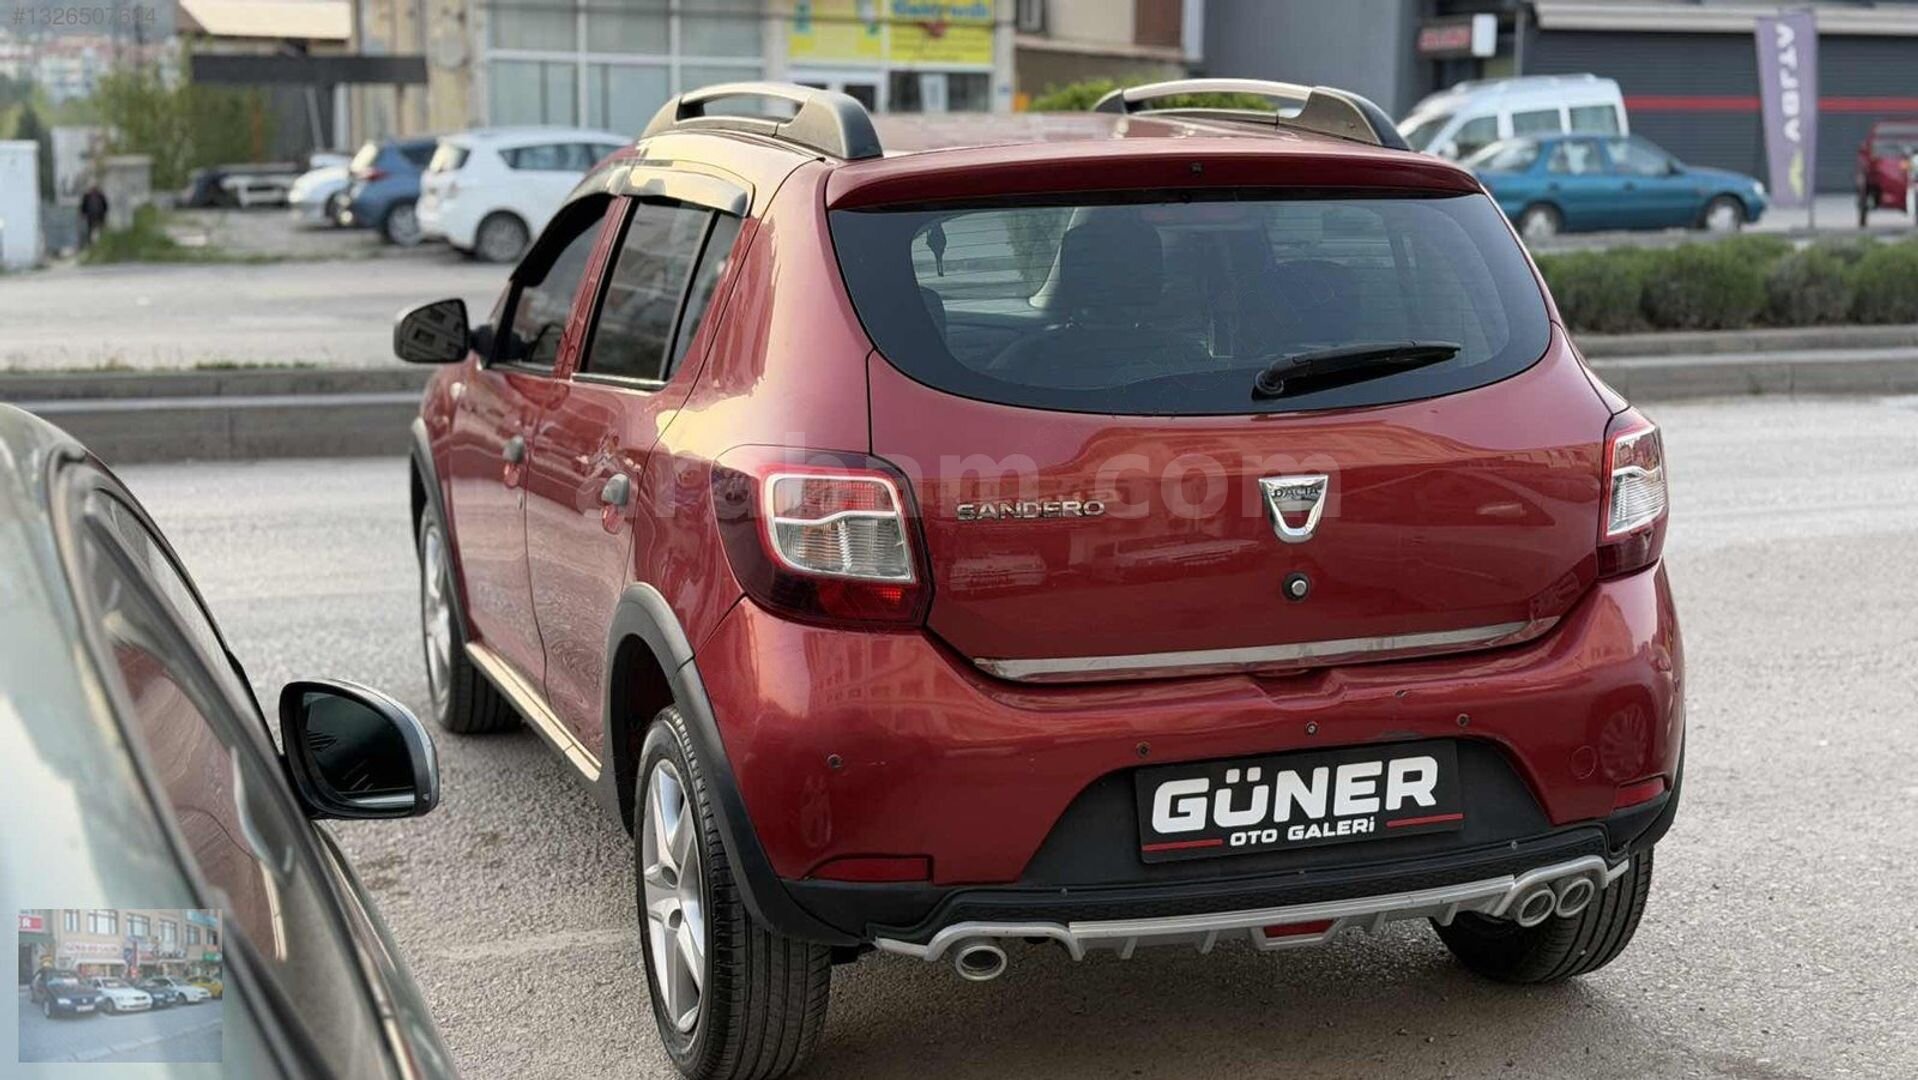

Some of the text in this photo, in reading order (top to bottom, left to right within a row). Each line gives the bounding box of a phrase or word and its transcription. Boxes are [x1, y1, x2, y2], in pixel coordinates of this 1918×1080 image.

[1273, 486, 1319, 498] DACIA
[956, 500, 1106, 521] SANDERO
[1152, 756, 1438, 833] GÜNER
[1229, 829, 1277, 847] OTO
